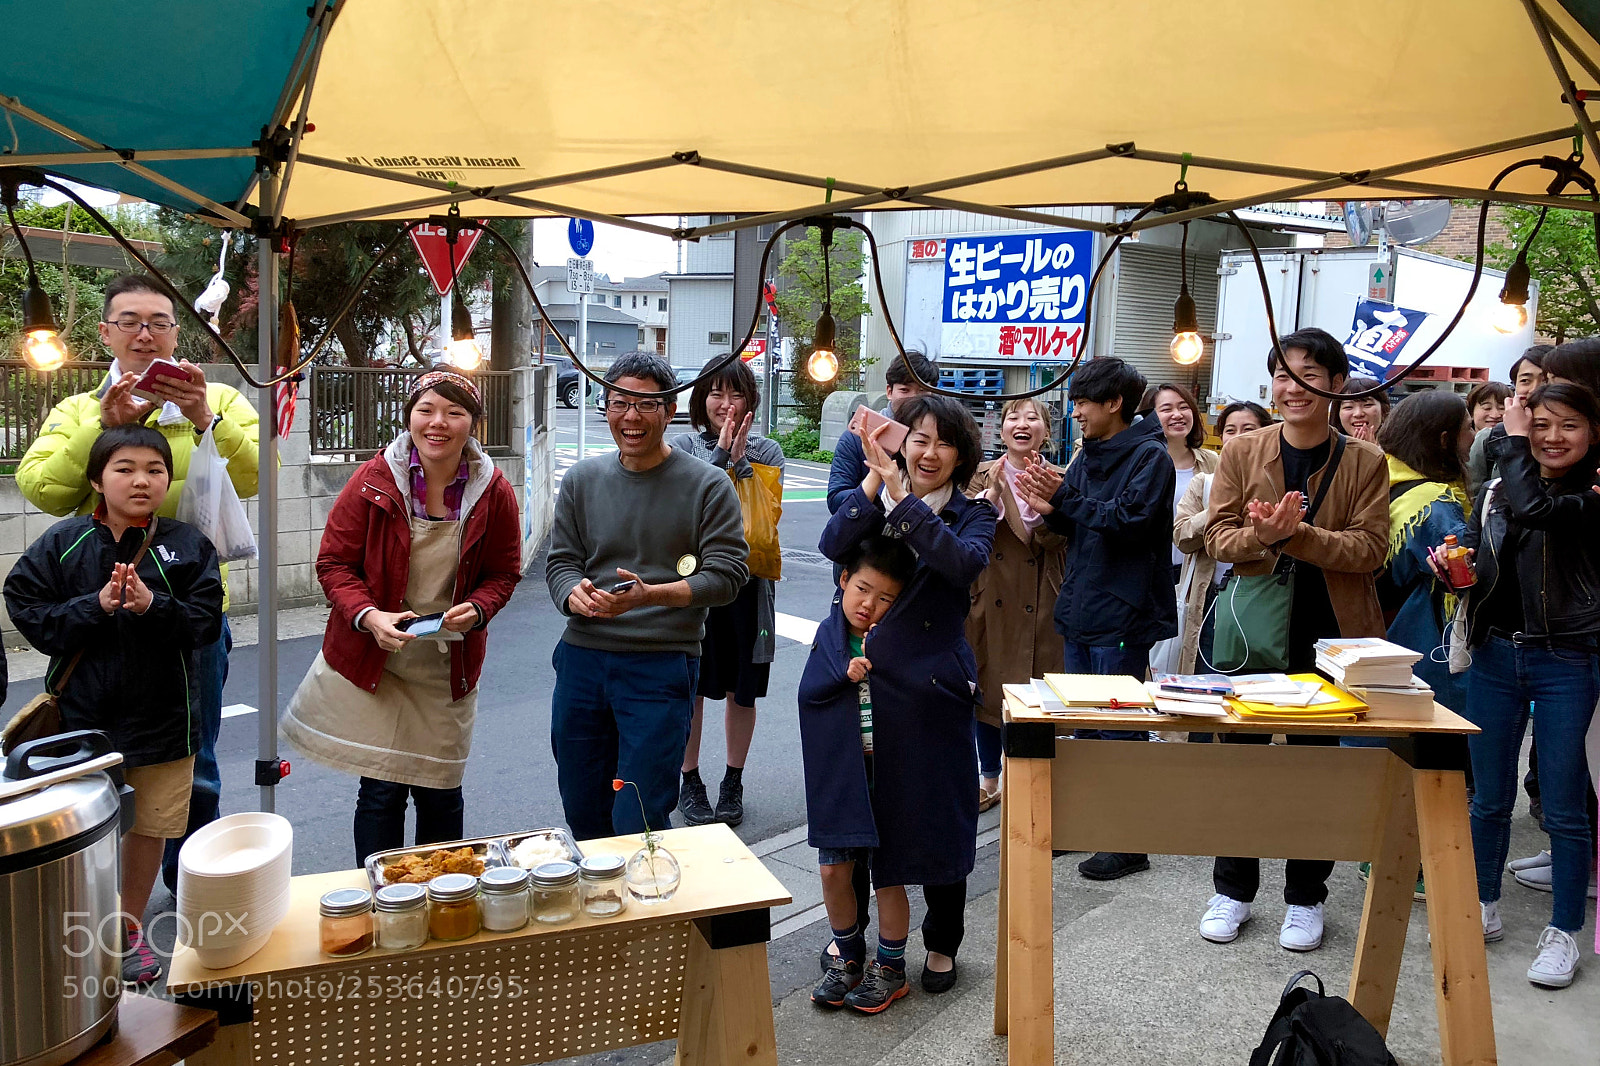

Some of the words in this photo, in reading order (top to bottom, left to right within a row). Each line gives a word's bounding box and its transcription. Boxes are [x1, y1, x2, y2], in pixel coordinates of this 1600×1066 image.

[948, 238, 1075, 287] 生ビールの
[951, 273, 1086, 321] はかり売り
[998, 325, 1084, 358] 酒のマルケイ
